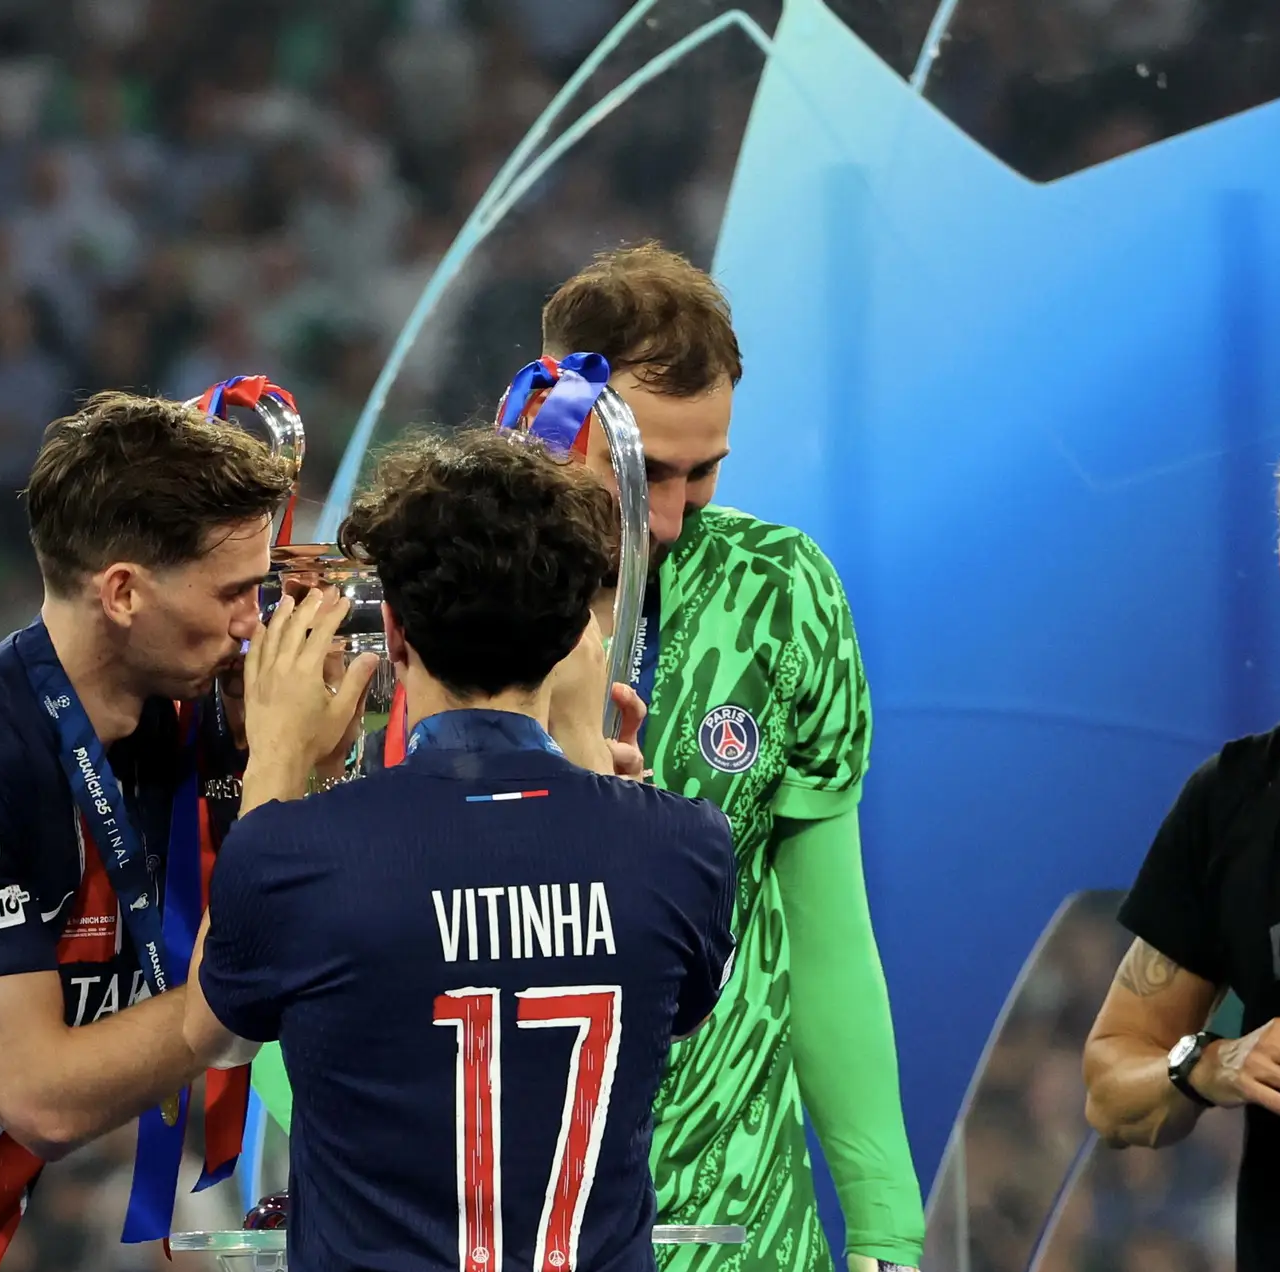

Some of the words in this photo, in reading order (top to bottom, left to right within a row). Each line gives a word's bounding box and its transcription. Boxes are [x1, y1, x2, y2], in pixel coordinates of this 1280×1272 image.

[705, 708, 746, 729] PARIS
[103, 817, 130, 869] FINAL
[431, 882, 616, 962] VITINHA
